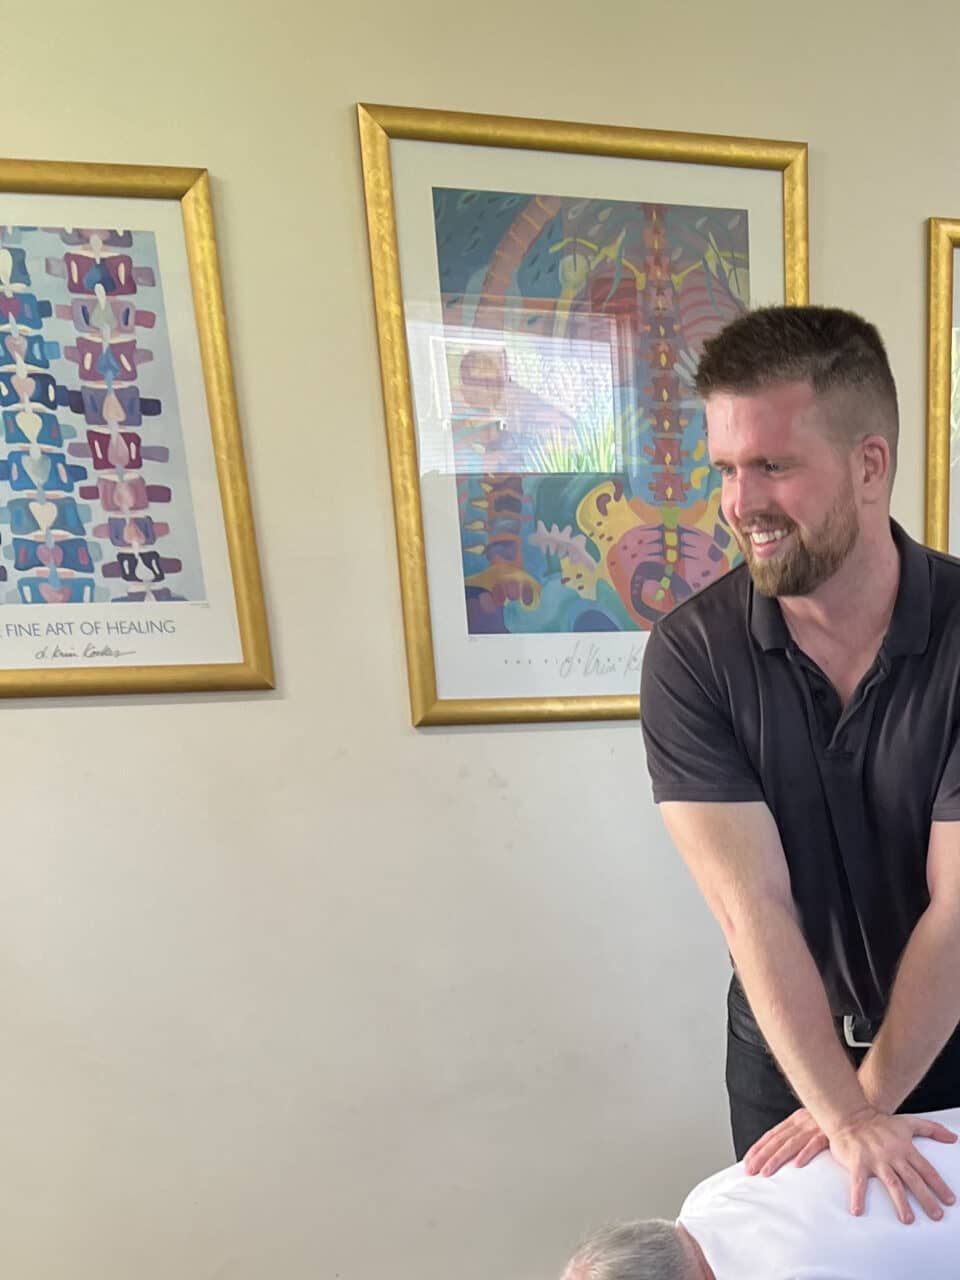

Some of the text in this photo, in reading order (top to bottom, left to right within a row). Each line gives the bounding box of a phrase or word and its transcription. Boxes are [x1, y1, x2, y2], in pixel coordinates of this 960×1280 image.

[5, 619, 176, 638] FINE ART OF HEALING
